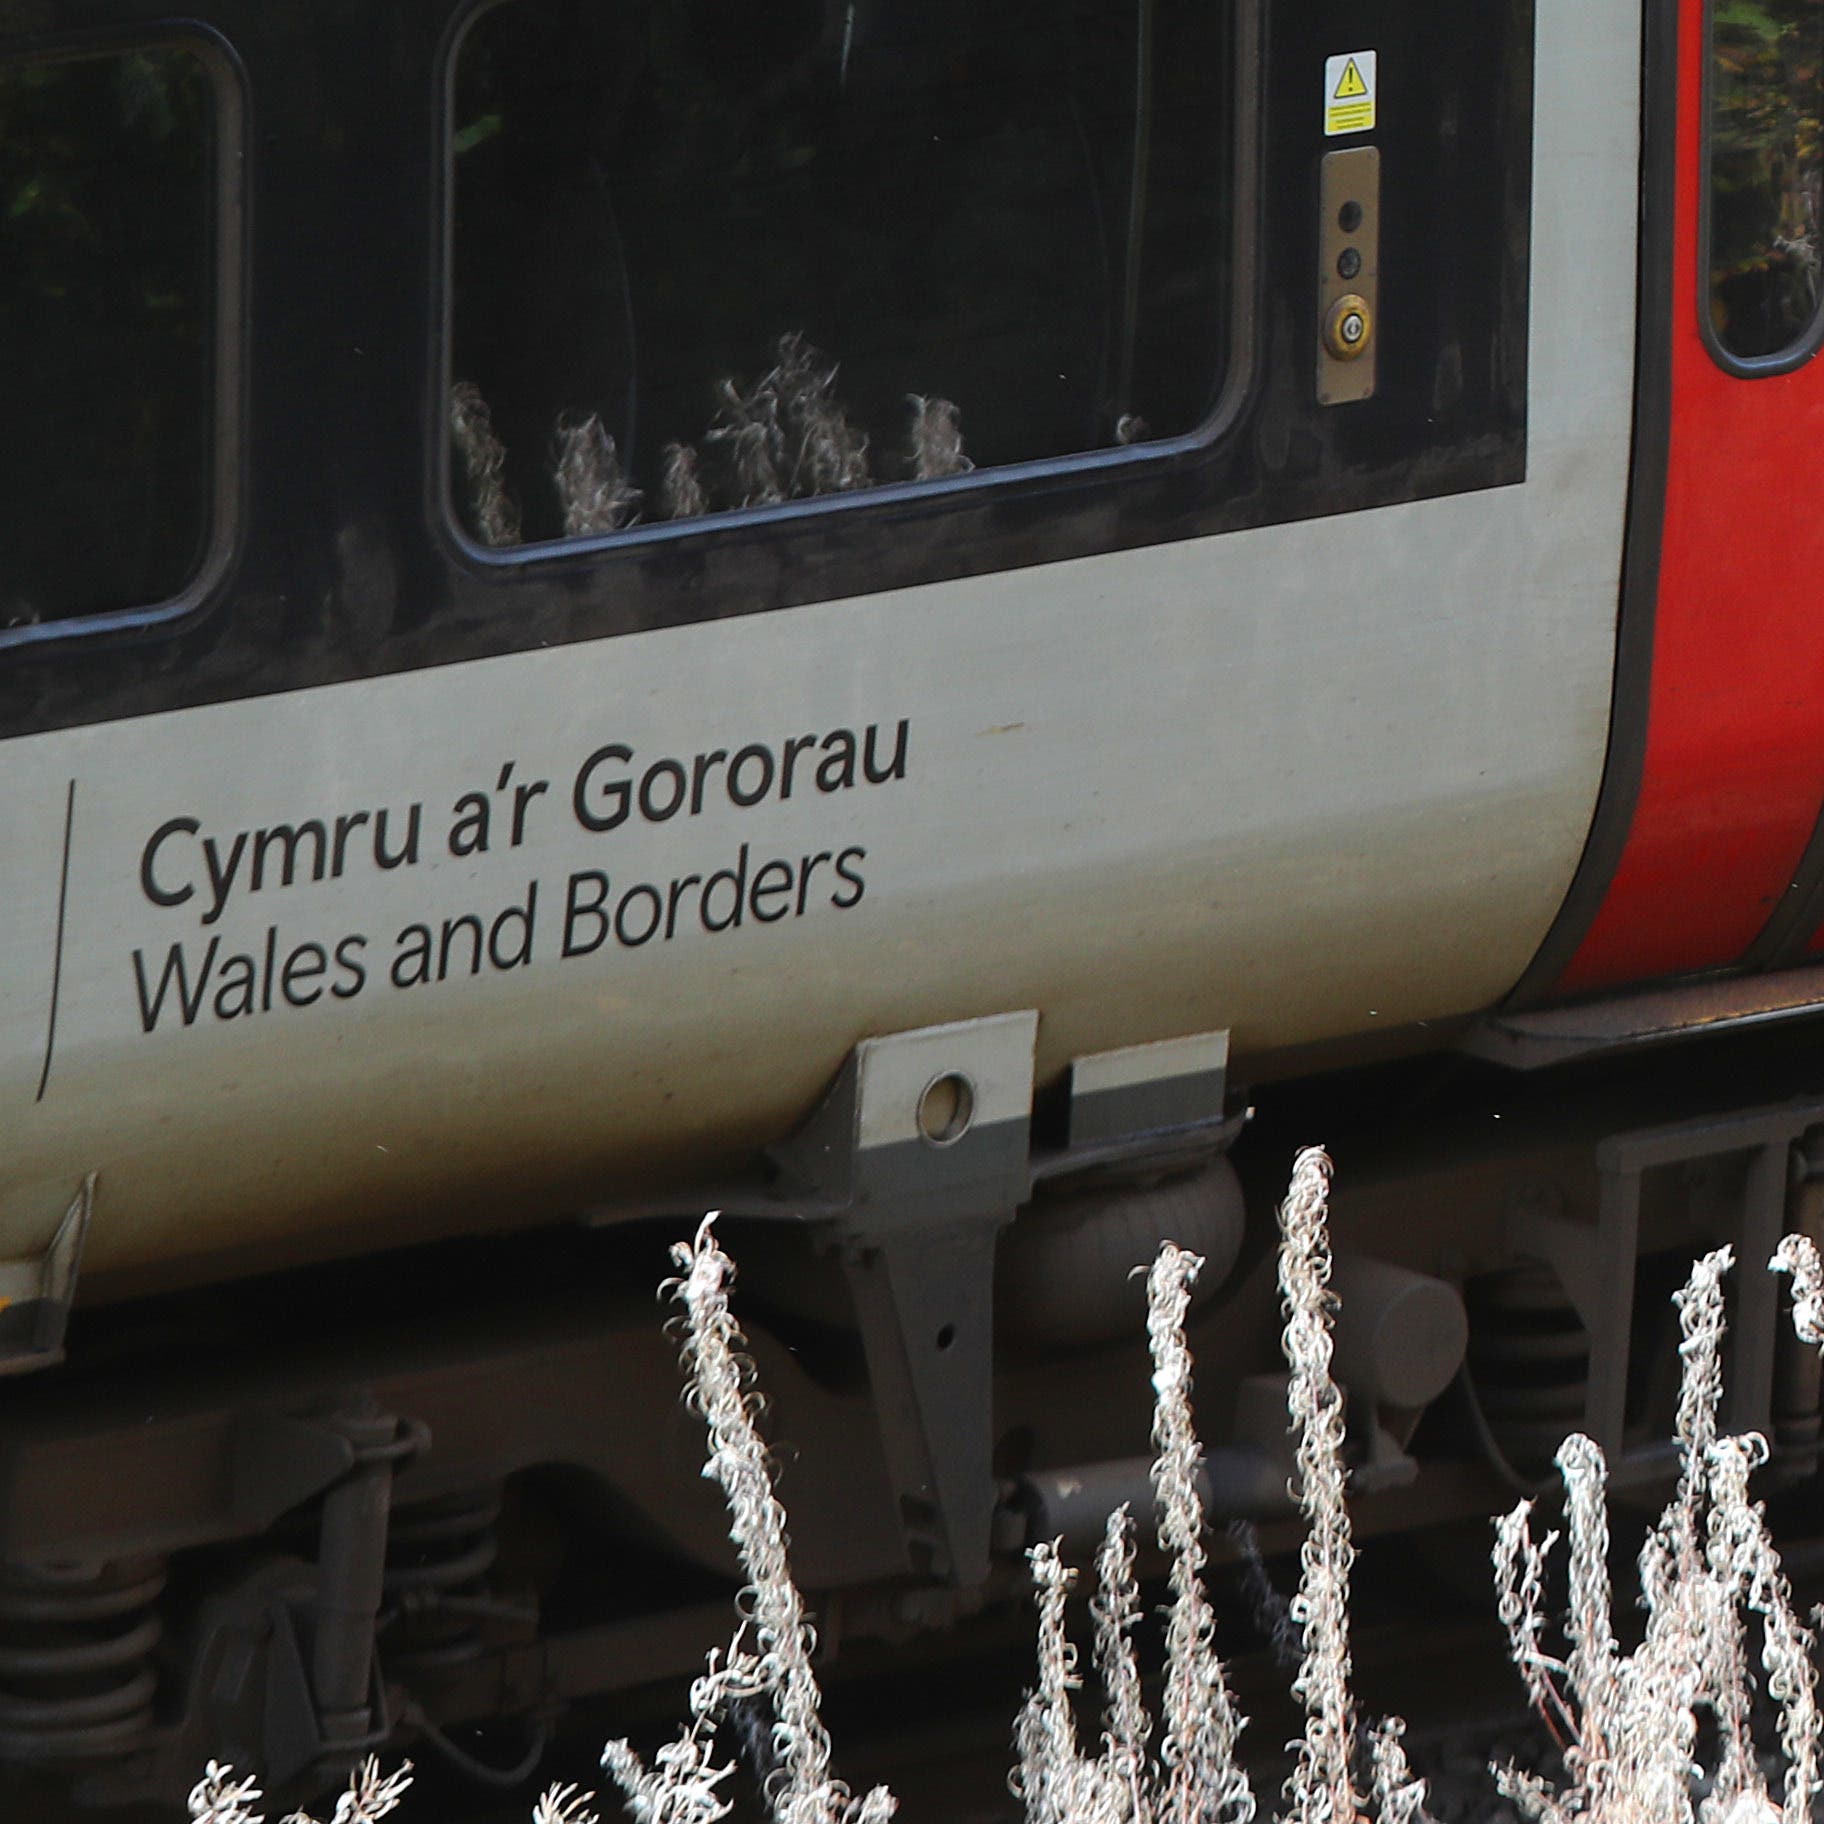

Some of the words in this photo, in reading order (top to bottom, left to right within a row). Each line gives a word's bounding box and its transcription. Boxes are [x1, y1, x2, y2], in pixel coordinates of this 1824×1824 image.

[140, 802, 423, 926] Cymru
[449, 760, 550, 858] a'r
[572, 718, 911, 833] Gororau
[131, 925, 369, 1033] Wales
[390, 878, 538, 989] and
[560, 841, 868, 960] Borders
